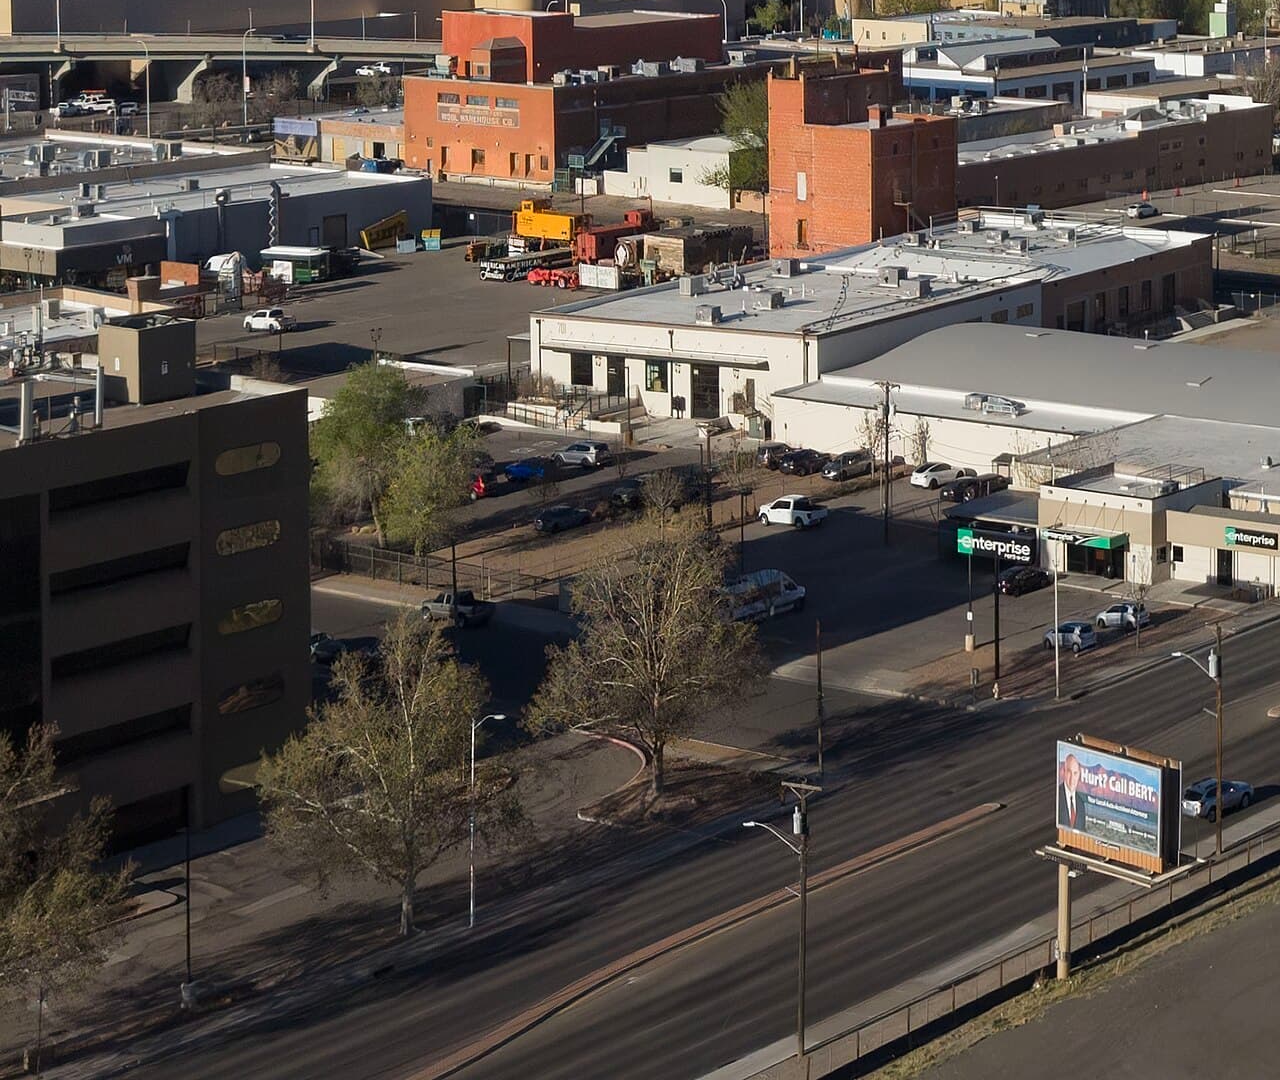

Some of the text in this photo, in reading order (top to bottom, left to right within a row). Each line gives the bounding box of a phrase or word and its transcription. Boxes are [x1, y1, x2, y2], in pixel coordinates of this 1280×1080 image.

[480, 260, 505, 270] AMERICAN
[958, 535, 1030, 556] enterprise
[1226, 532, 1275, 546] enterprise
[1080, 767, 1156, 802] Hurt? Call BERT.
